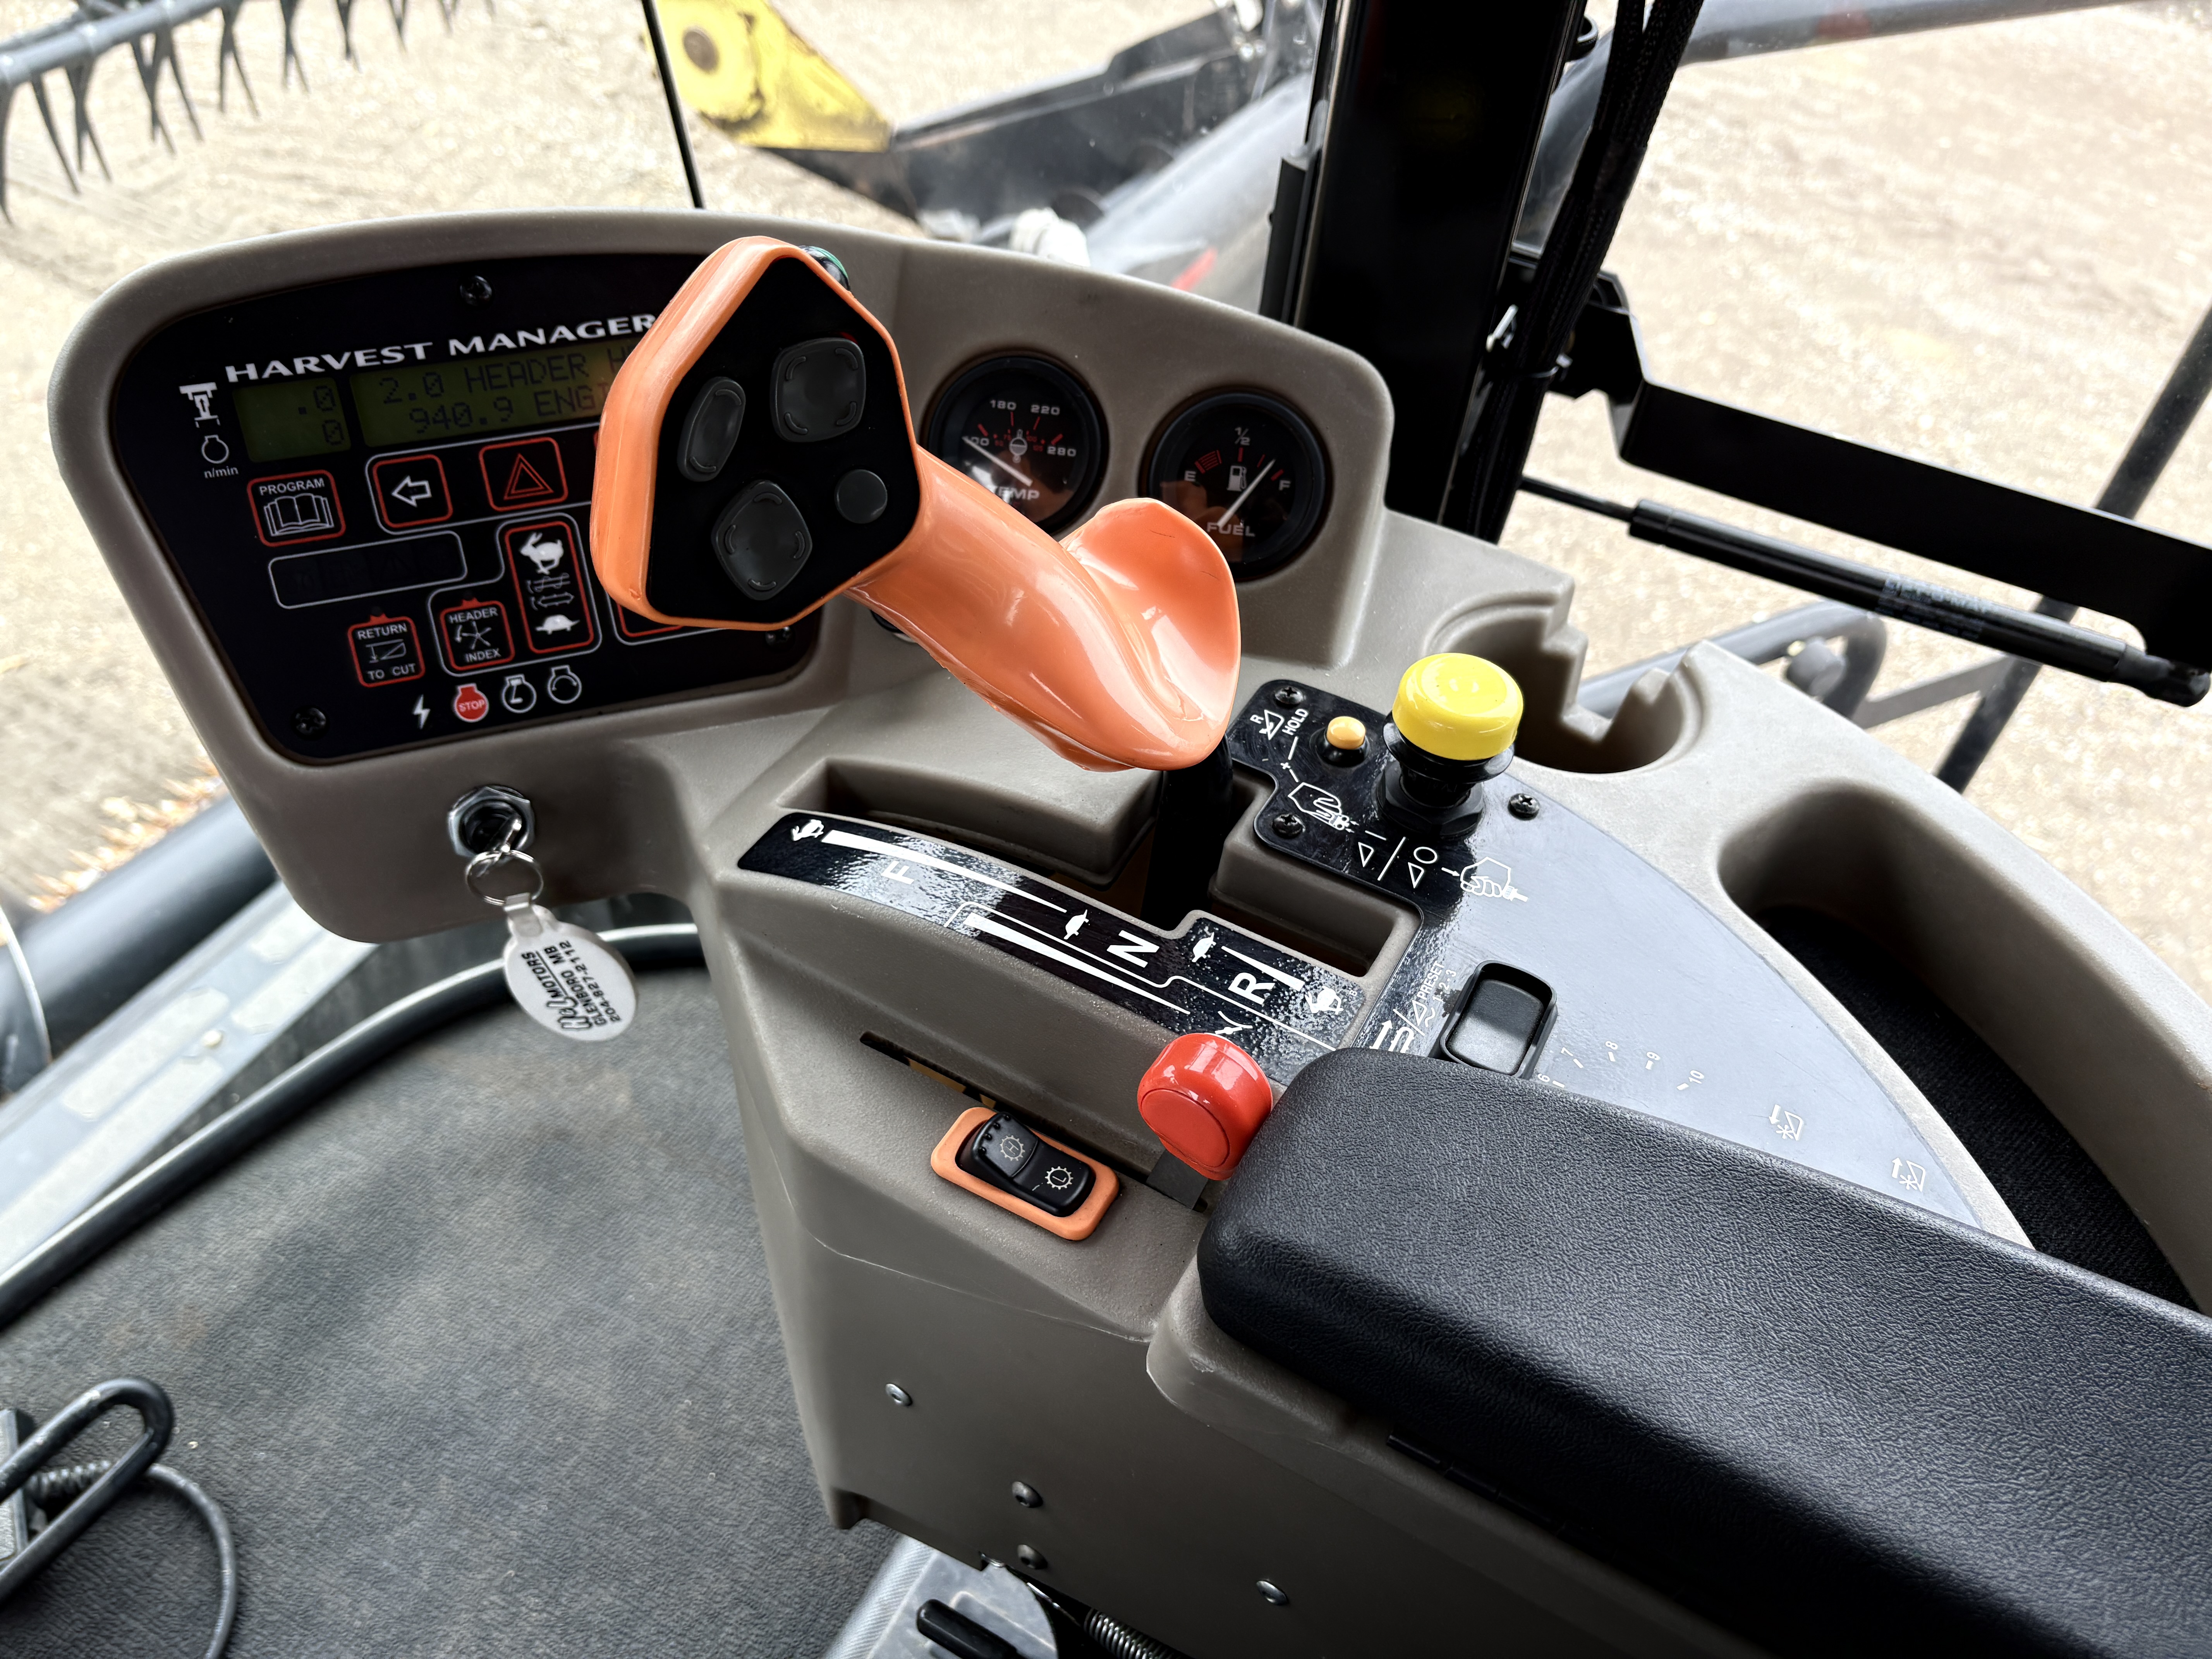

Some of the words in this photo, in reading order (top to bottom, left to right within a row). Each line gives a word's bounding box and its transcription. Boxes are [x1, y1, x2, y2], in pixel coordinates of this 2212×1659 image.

[225, 342, 433, 382] HARVEST
[448, 314, 656, 356] MANAGER
[379, 372, 445, 404] 2.0
[464, 353, 589, 393] HEADER
[990, 400, 1017, 410] 180
[1030, 405, 1060, 416] 220
[409, 397, 513, 433] 940.9
[322, 419, 344, 445] 0
[1047, 446, 1077, 457] 280
[204, 466, 239, 479] n/min
[1184, 470, 1197, 482] E
[259, 478, 325, 496] PROGRAM
[990, 485, 1040, 500] EMP
[1279, 480, 1291, 491] F
[1207, 522, 1255, 537] FUEL
[449, 607, 498, 623] HEADER
[357, 623, 407, 640] RETURN
[465, 648, 501, 662] INDEX
[368, 669, 385, 681] TO
[392, 664, 416, 677] CUT
[459, 699, 485, 712] STOP
[1250, 714, 1264, 724] R
[1282, 708, 1309, 736] HOLD
[881, 860, 915, 885] F
[544, 945, 565, 965] MB
[1106, 930, 1159, 968] N
[521, 952, 563, 998] MOTORS
[559, 940, 621, 1022] 204-827-2112
[1416, 960, 1444, 1000] PRESET
[1228, 972, 1275, 1005] R
[562, 970, 608, 1026] GLENBORO
[1561, 1047, 1573, 1056] 7
[1605, 1041, 1618, 1050] 8
[1646, 1051, 1660, 1061] 9
[1537, 1073, 1550, 1082] 6
[1688, 1070, 1704, 1084] 10
[1006, 1141, 1018, 1155] H
